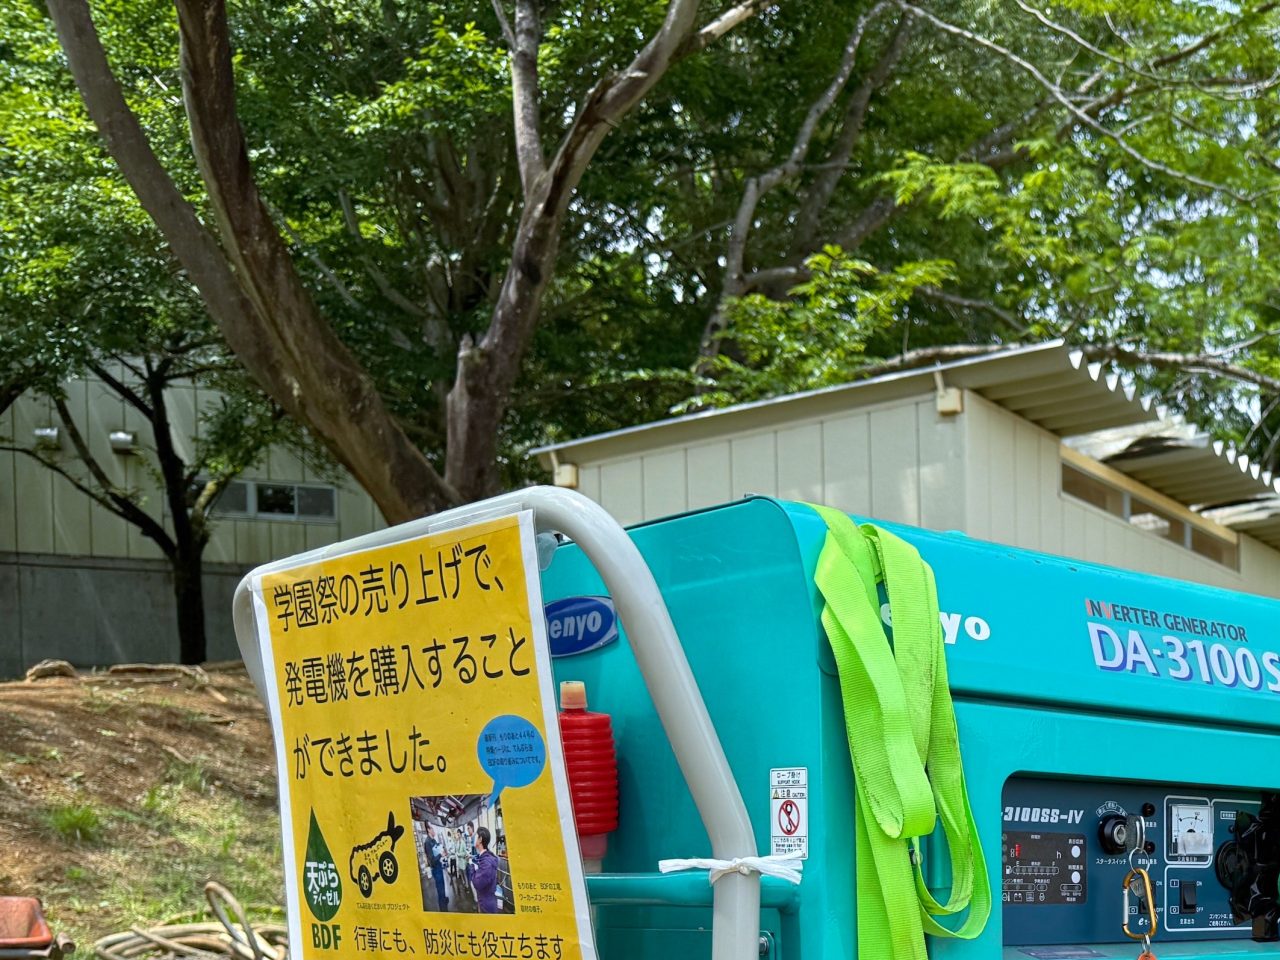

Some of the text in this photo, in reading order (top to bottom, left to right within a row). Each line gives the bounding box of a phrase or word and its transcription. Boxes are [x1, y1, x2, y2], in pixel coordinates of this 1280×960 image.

[273, 543, 505, 632] 学園祭の売り上げで、
[549, 610, 602, 641] enyo
[1085, 598, 1248, 643] INVERTER GENERATOR
[285, 626, 531, 708] 発電機を購入すること
[293, 725, 448, 781] ができました。
[306, 861, 339, 892] 天ぷら
[313, 890, 340, 906] ディーゼル
[311, 923, 342, 950] BDF
